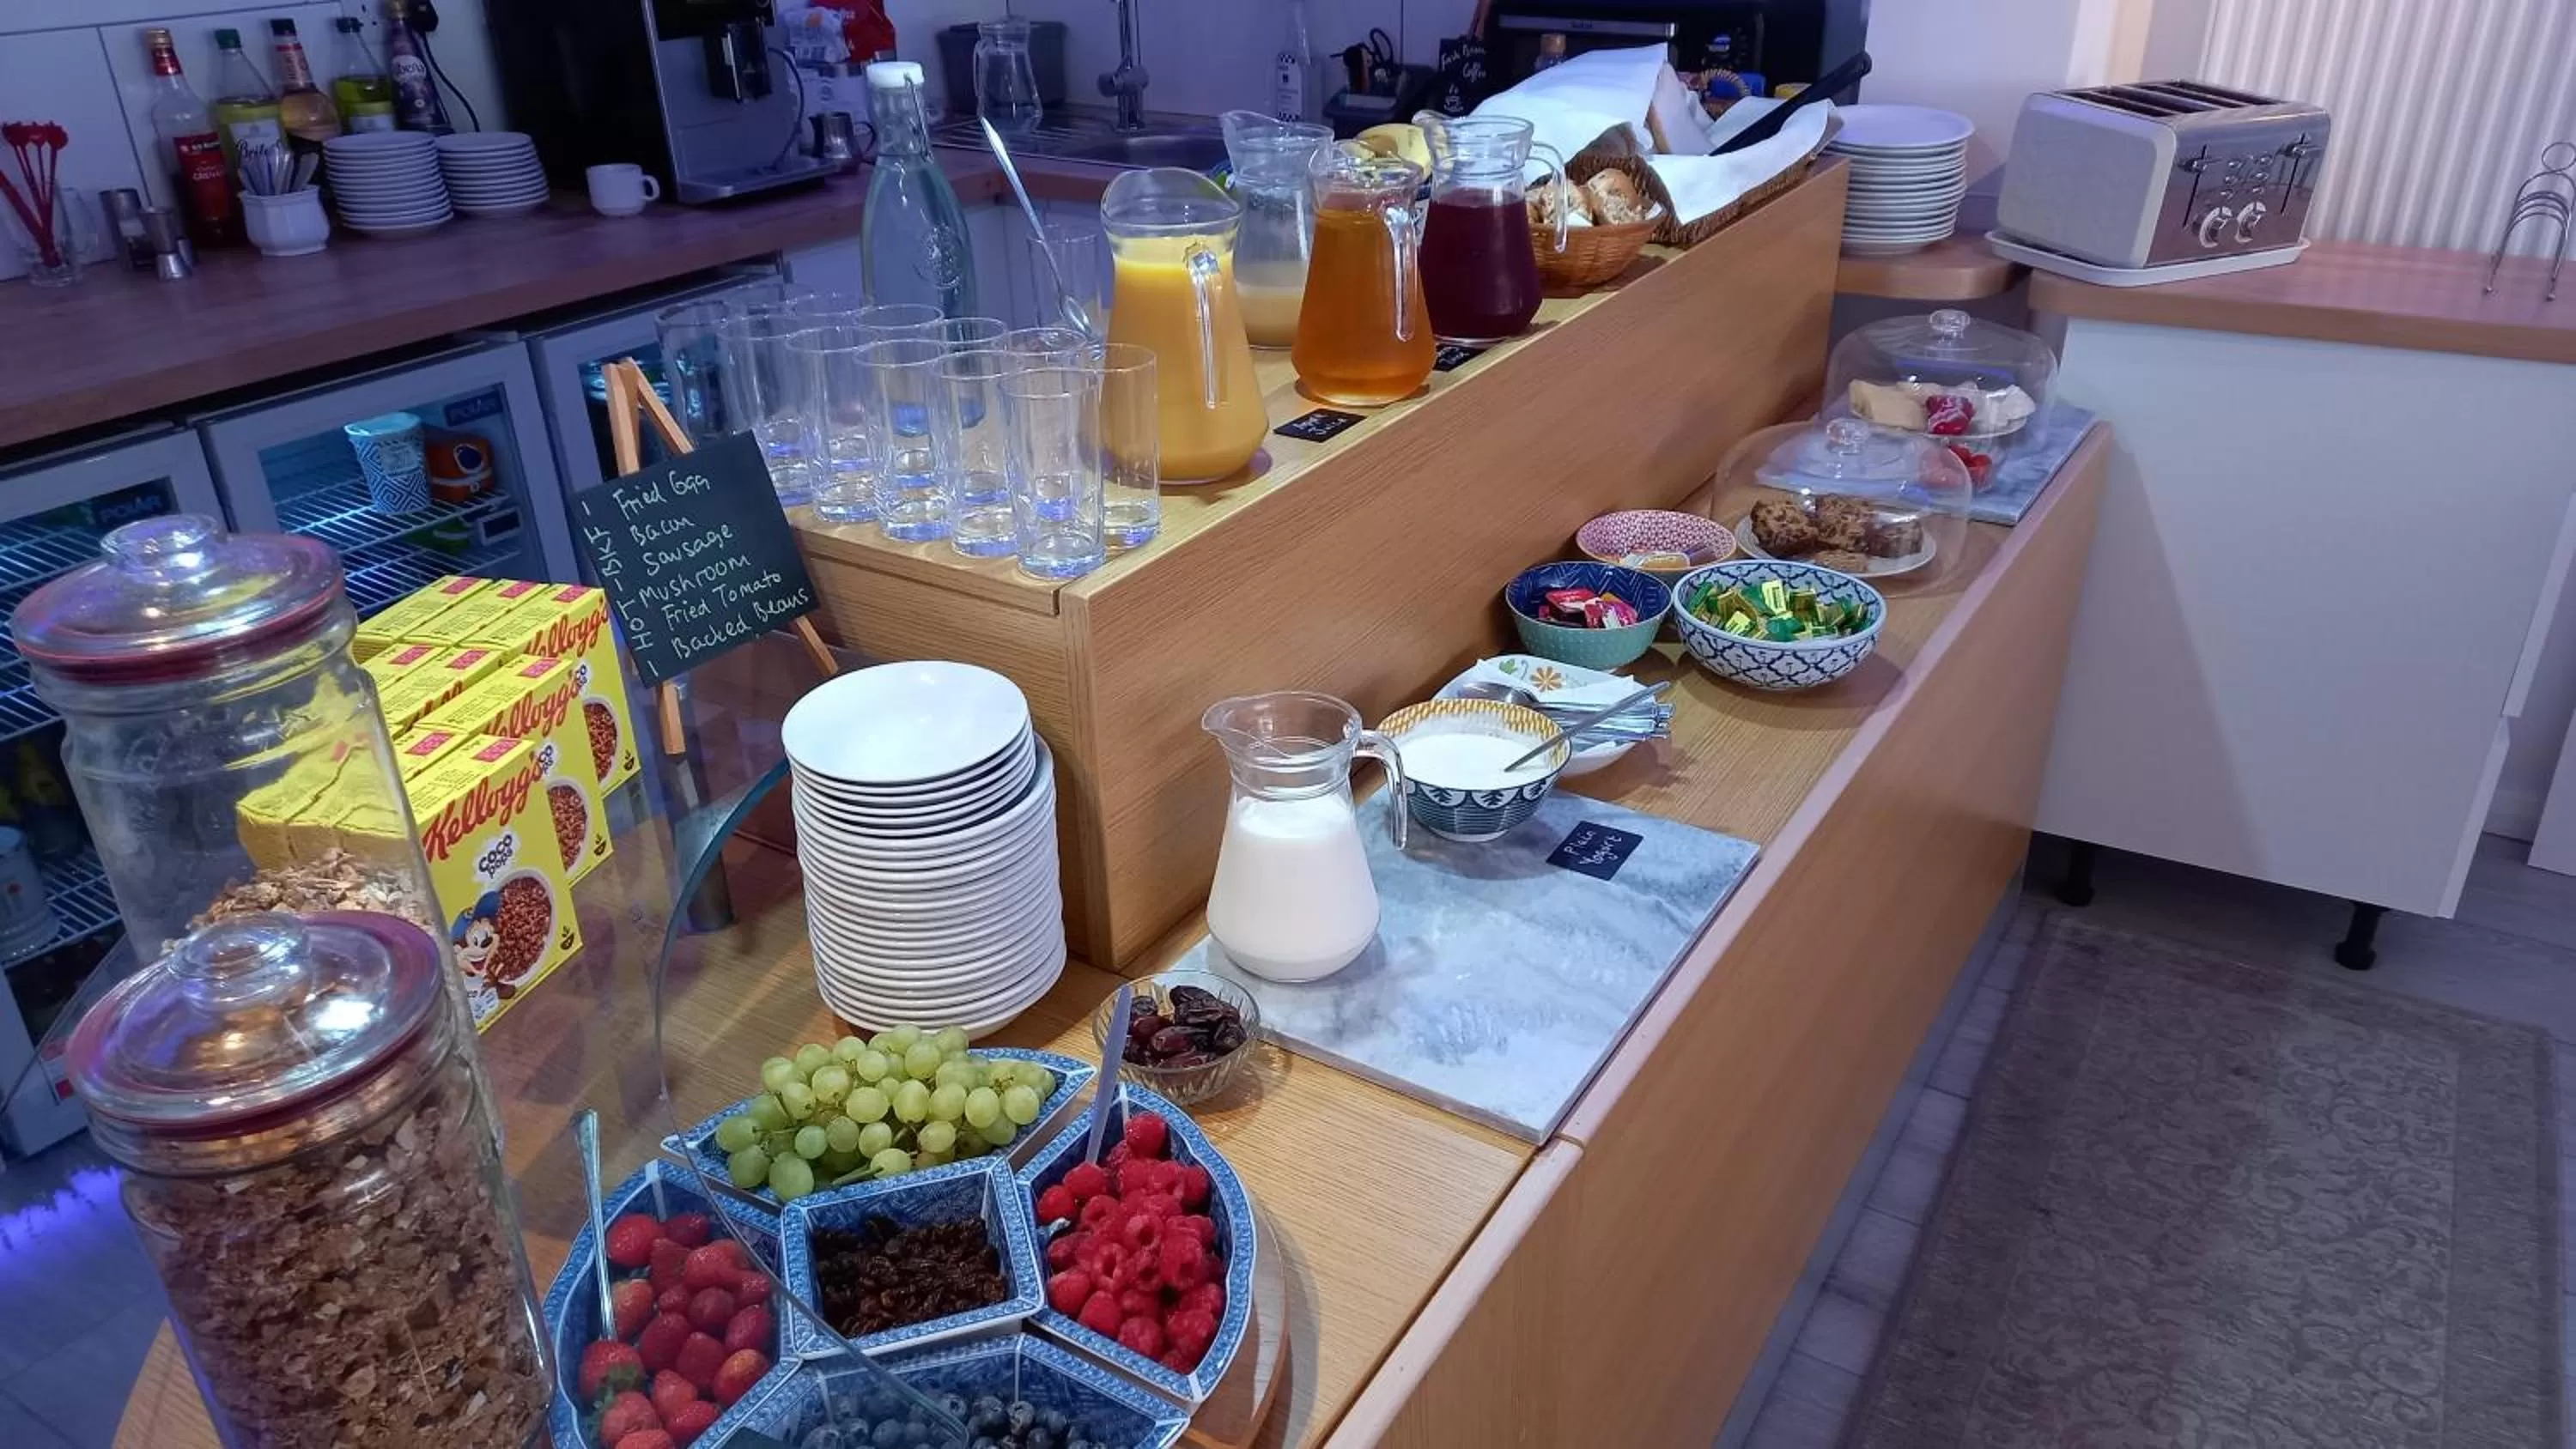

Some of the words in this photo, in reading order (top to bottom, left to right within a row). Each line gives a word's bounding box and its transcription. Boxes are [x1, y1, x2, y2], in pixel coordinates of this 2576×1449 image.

[612, 482, 667, 520] Fried
[629, 514, 696, 546] Bacon
[643, 523, 734, 577] Sausage
[638, 554, 752, 608] Mushroom
[661, 599, 712, 632] Fried
[712, 571, 782, 608] Tomato
[753, 587, 810, 623] Beans
[422, 749, 543, 864] Kellogg's
